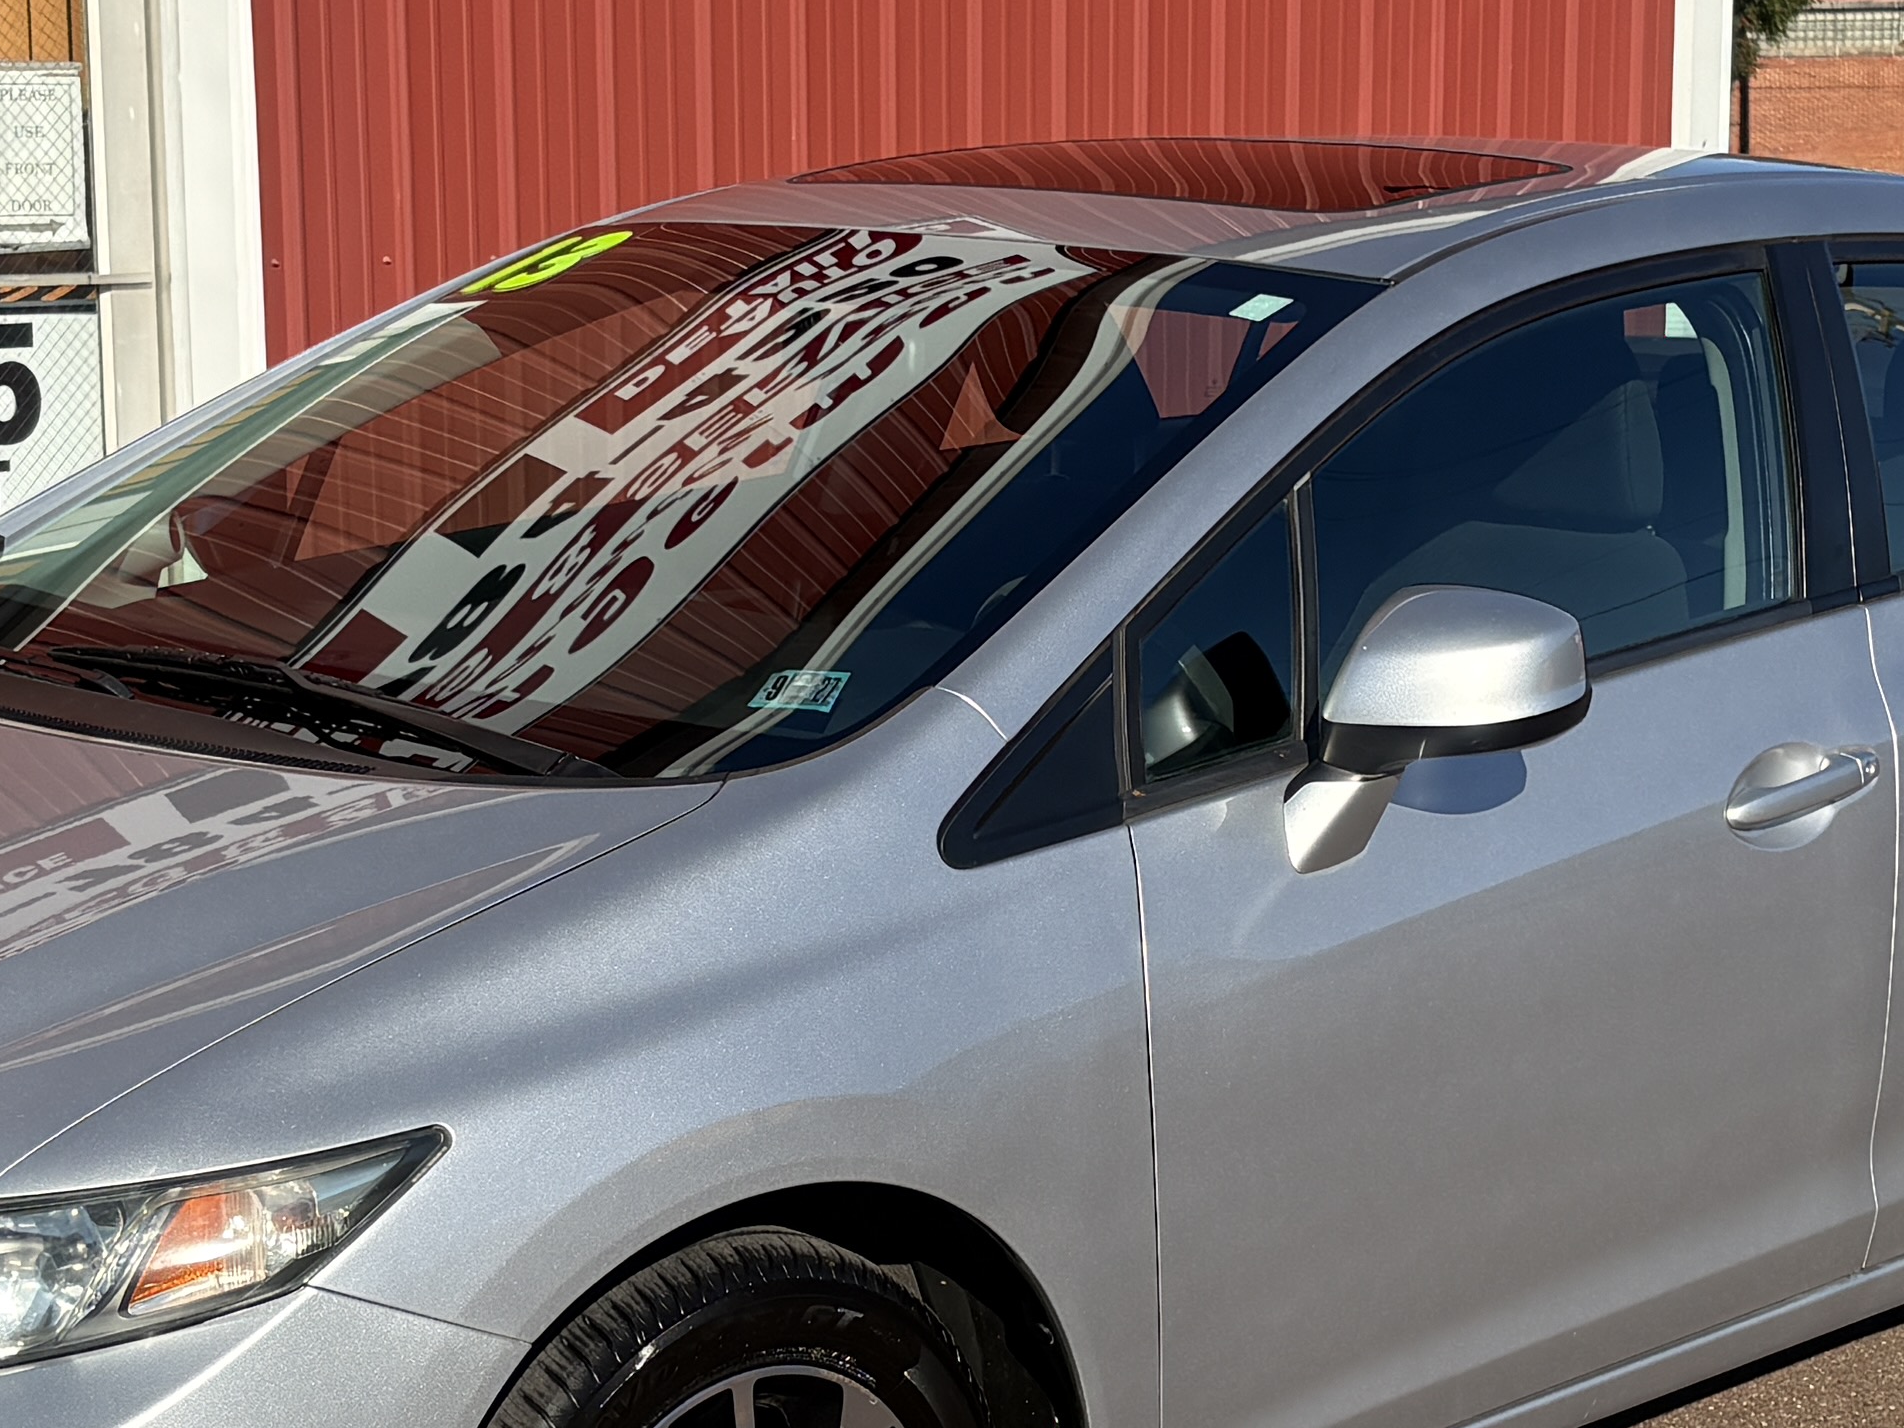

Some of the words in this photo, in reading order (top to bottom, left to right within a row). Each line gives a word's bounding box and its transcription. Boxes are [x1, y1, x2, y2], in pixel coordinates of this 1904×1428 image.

[0, 87, 57, 102] PLEASE
[14, 125, 45, 139] USE
[5, 162, 55, 176] FRONT
[11, 199, 53, 213] DOOR
